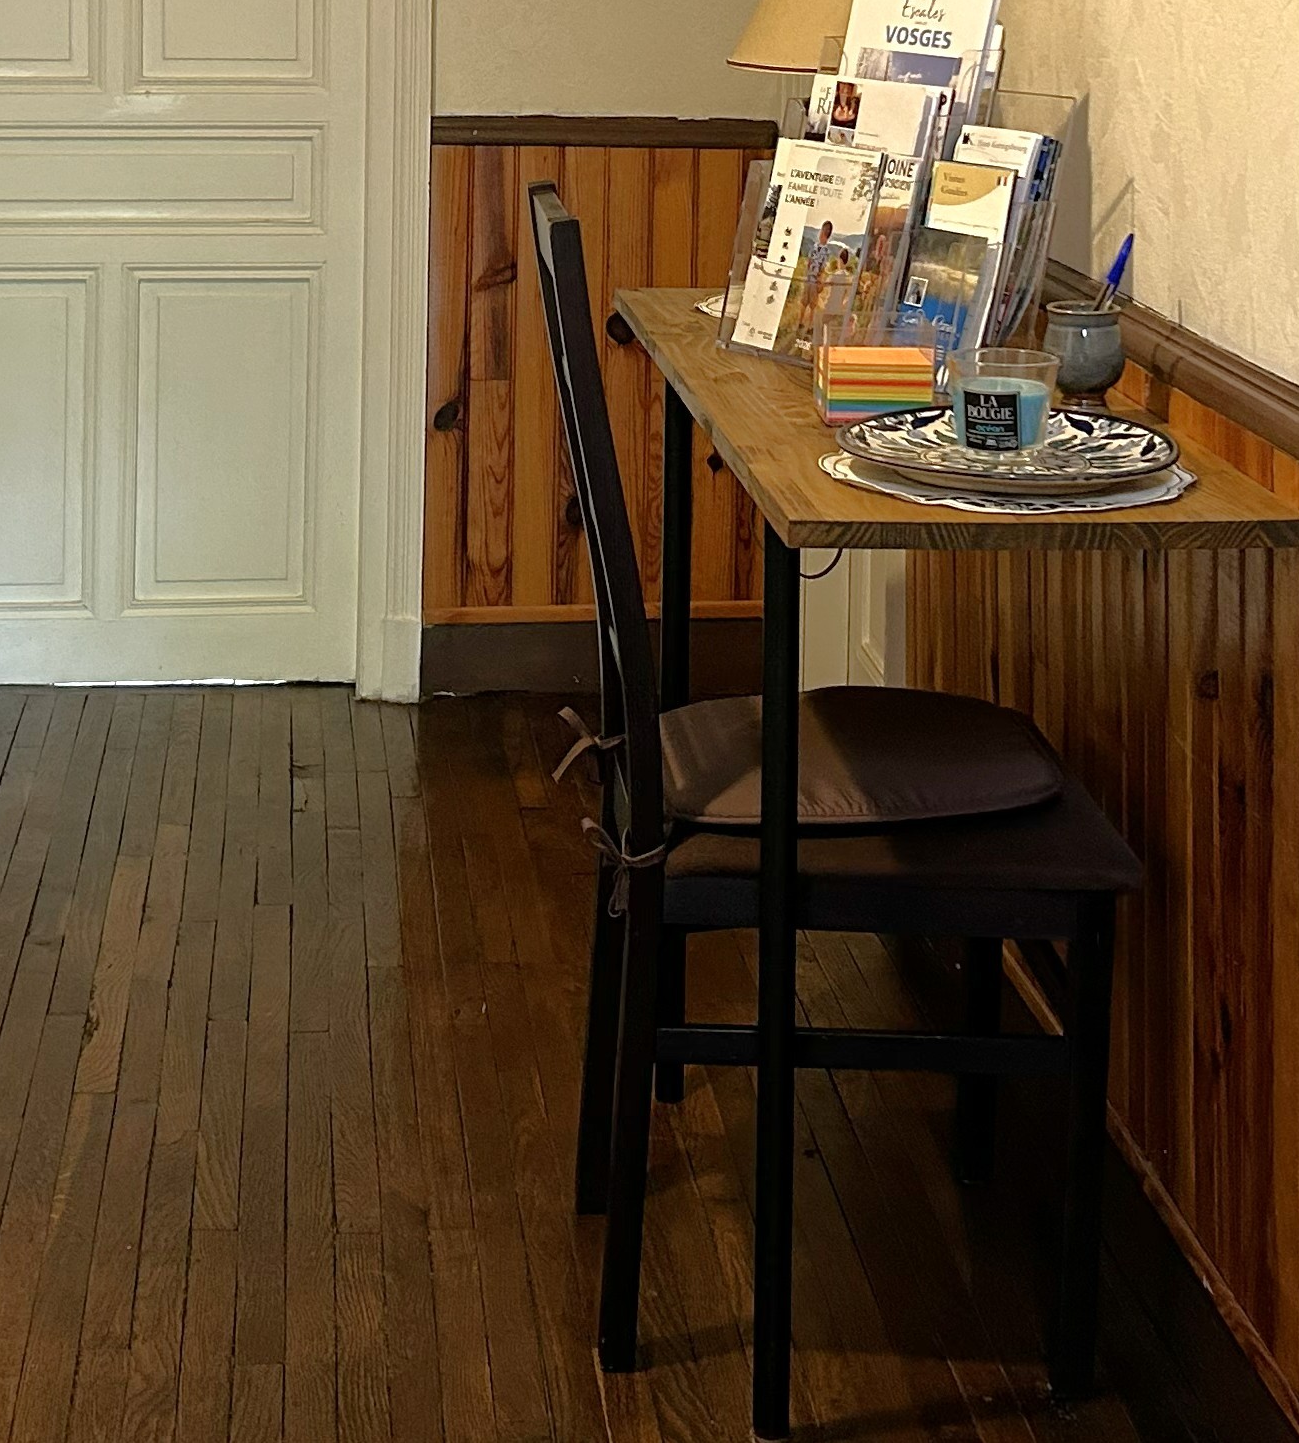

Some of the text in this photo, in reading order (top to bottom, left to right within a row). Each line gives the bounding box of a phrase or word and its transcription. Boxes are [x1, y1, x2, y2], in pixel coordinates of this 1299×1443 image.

[886, 25, 952, 49] VOSGES
[790, 168, 834, 185] L'AVENTURE
[787, 181, 818, 195] FAMILLE
[980, 394, 998, 407] LA
[967, 404, 1015, 420] BOUGIE
